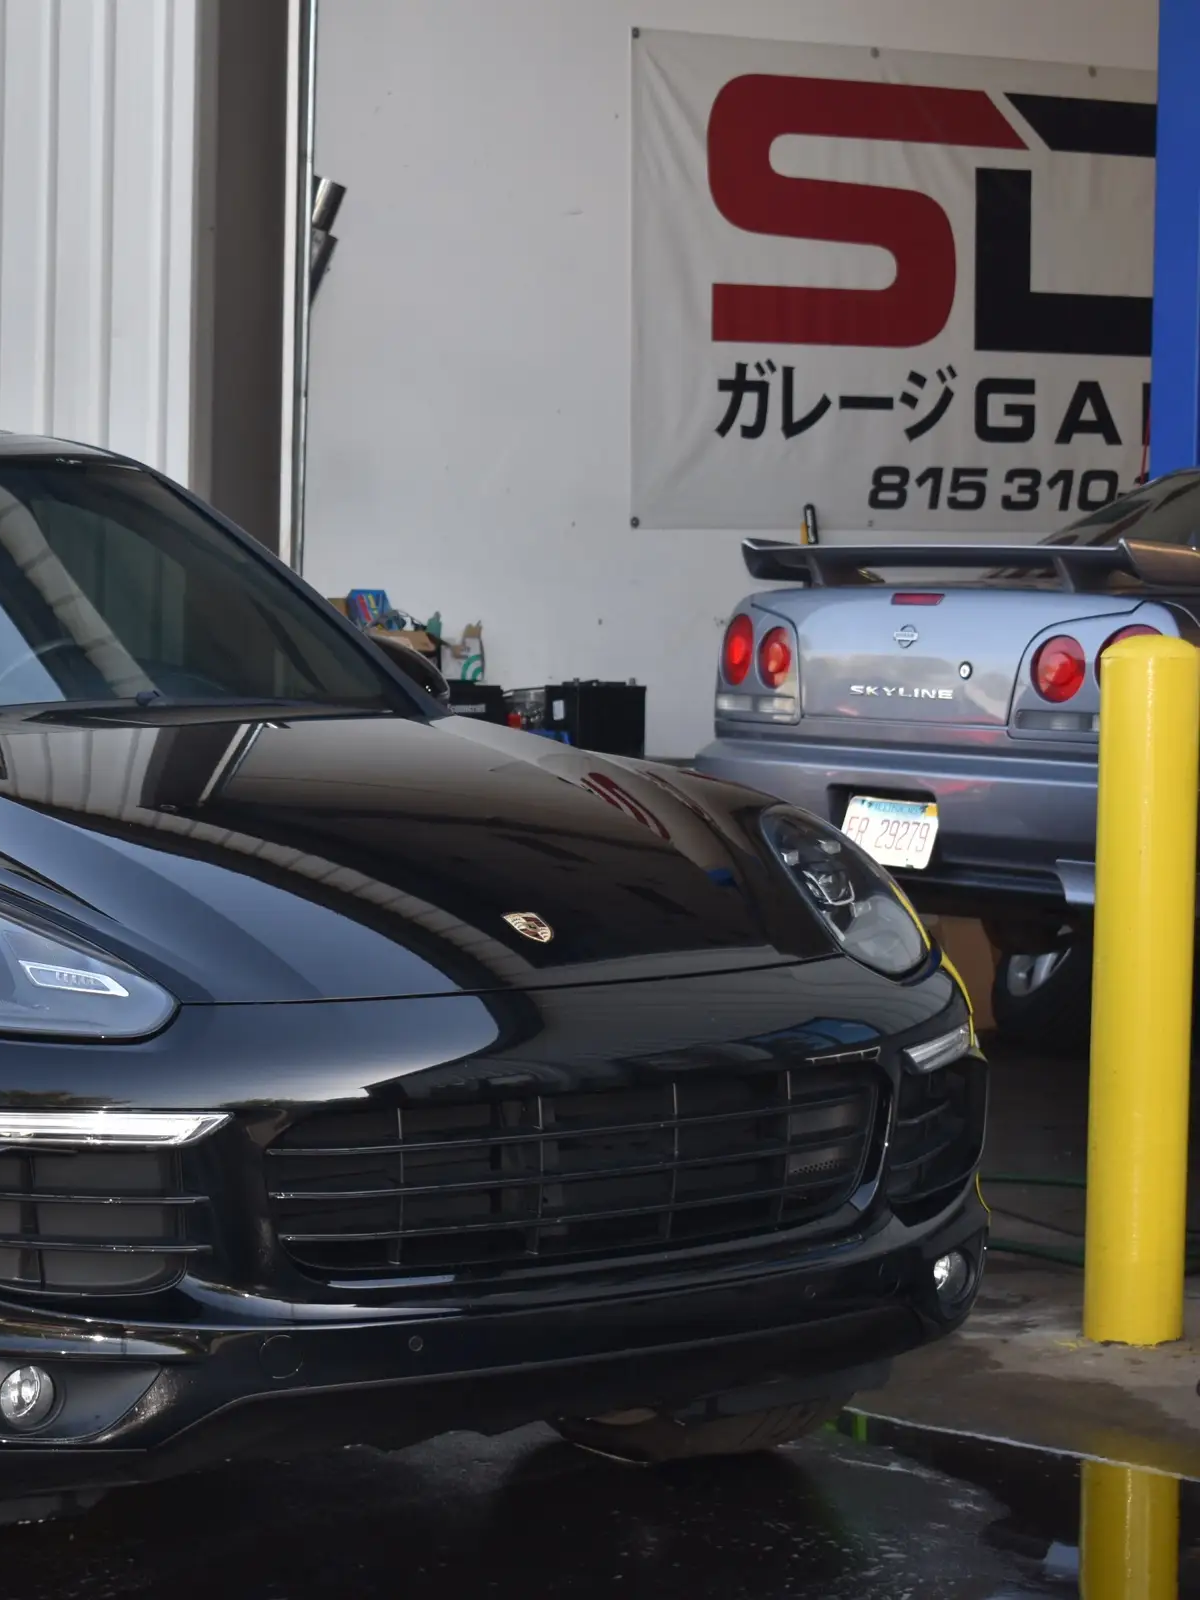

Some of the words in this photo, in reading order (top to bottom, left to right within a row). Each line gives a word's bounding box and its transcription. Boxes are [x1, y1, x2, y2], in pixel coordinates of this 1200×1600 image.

[715, 358, 958, 442] ガレージ
[973, 377, 1151, 446] GA
[867, 465, 990, 511] 815
[849, 684, 954, 700] SKYLINE
[874, 819, 931, 852] 29279
